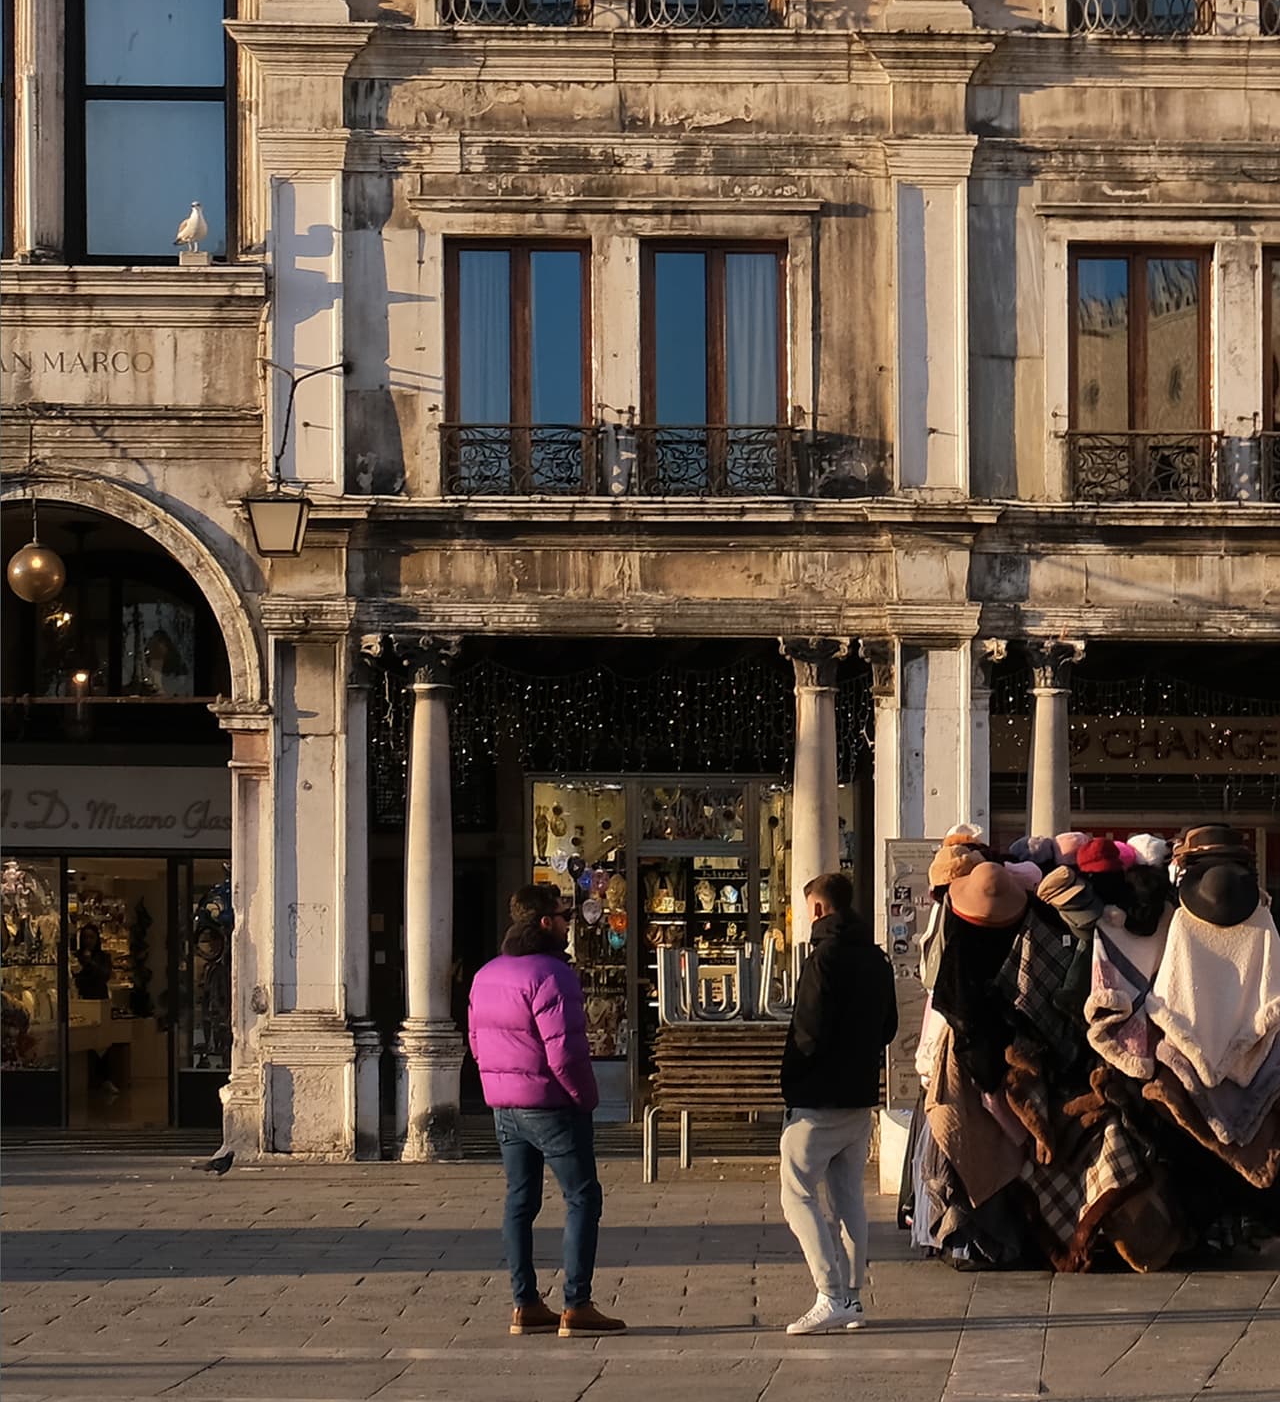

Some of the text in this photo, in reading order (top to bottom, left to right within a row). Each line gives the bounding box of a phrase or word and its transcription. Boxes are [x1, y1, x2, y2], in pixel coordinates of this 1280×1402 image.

[43, 351, 154, 374] MARCO
[1103, 729, 1280, 763] CHANGE
[86, 797, 177, 830] Murano
